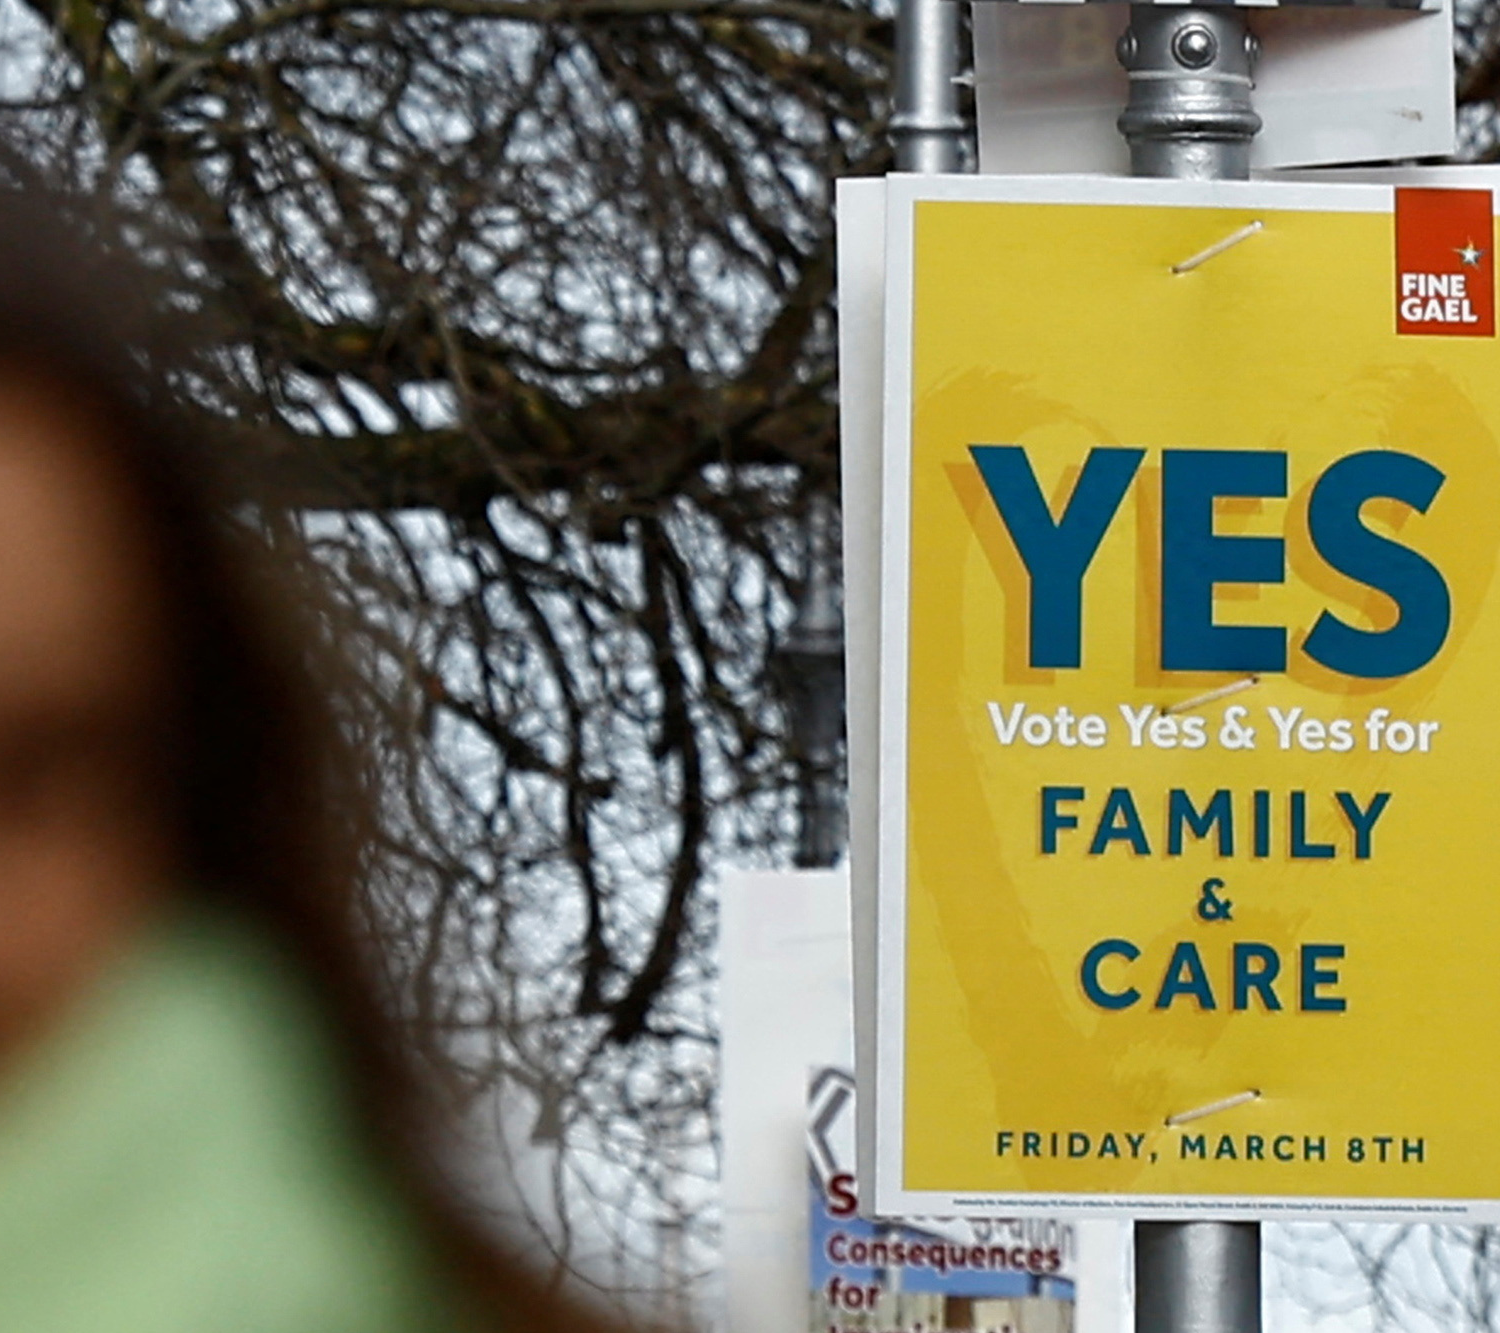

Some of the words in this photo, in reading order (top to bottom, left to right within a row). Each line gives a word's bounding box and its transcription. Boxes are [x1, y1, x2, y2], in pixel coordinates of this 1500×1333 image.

[1402, 273, 1466, 298] FINE
[1401, 297, 1478, 323] GAEL
[967, 444, 1451, 679] YES
[987, 702, 1107, 749] Vote
[1120, 703, 1207, 750] Yes
[1218, 706, 1255, 749] &
[1268, 707, 1354, 751] Yes
[1365, 708, 1439, 752] for
[1039, 786, 1392, 859] FAMILY
[1198, 877, 1233, 920] &
[1080, 938, 1347, 1012] CARE
[996, 1131, 1158, 1164] FRIDAY,
[1180, 1134, 1326, 1162] MARCH
[1347, 1136, 1425, 1164] 8TH
[827, 1234, 1061, 1274] Consequences
[827, 1277, 881, 1310] for
